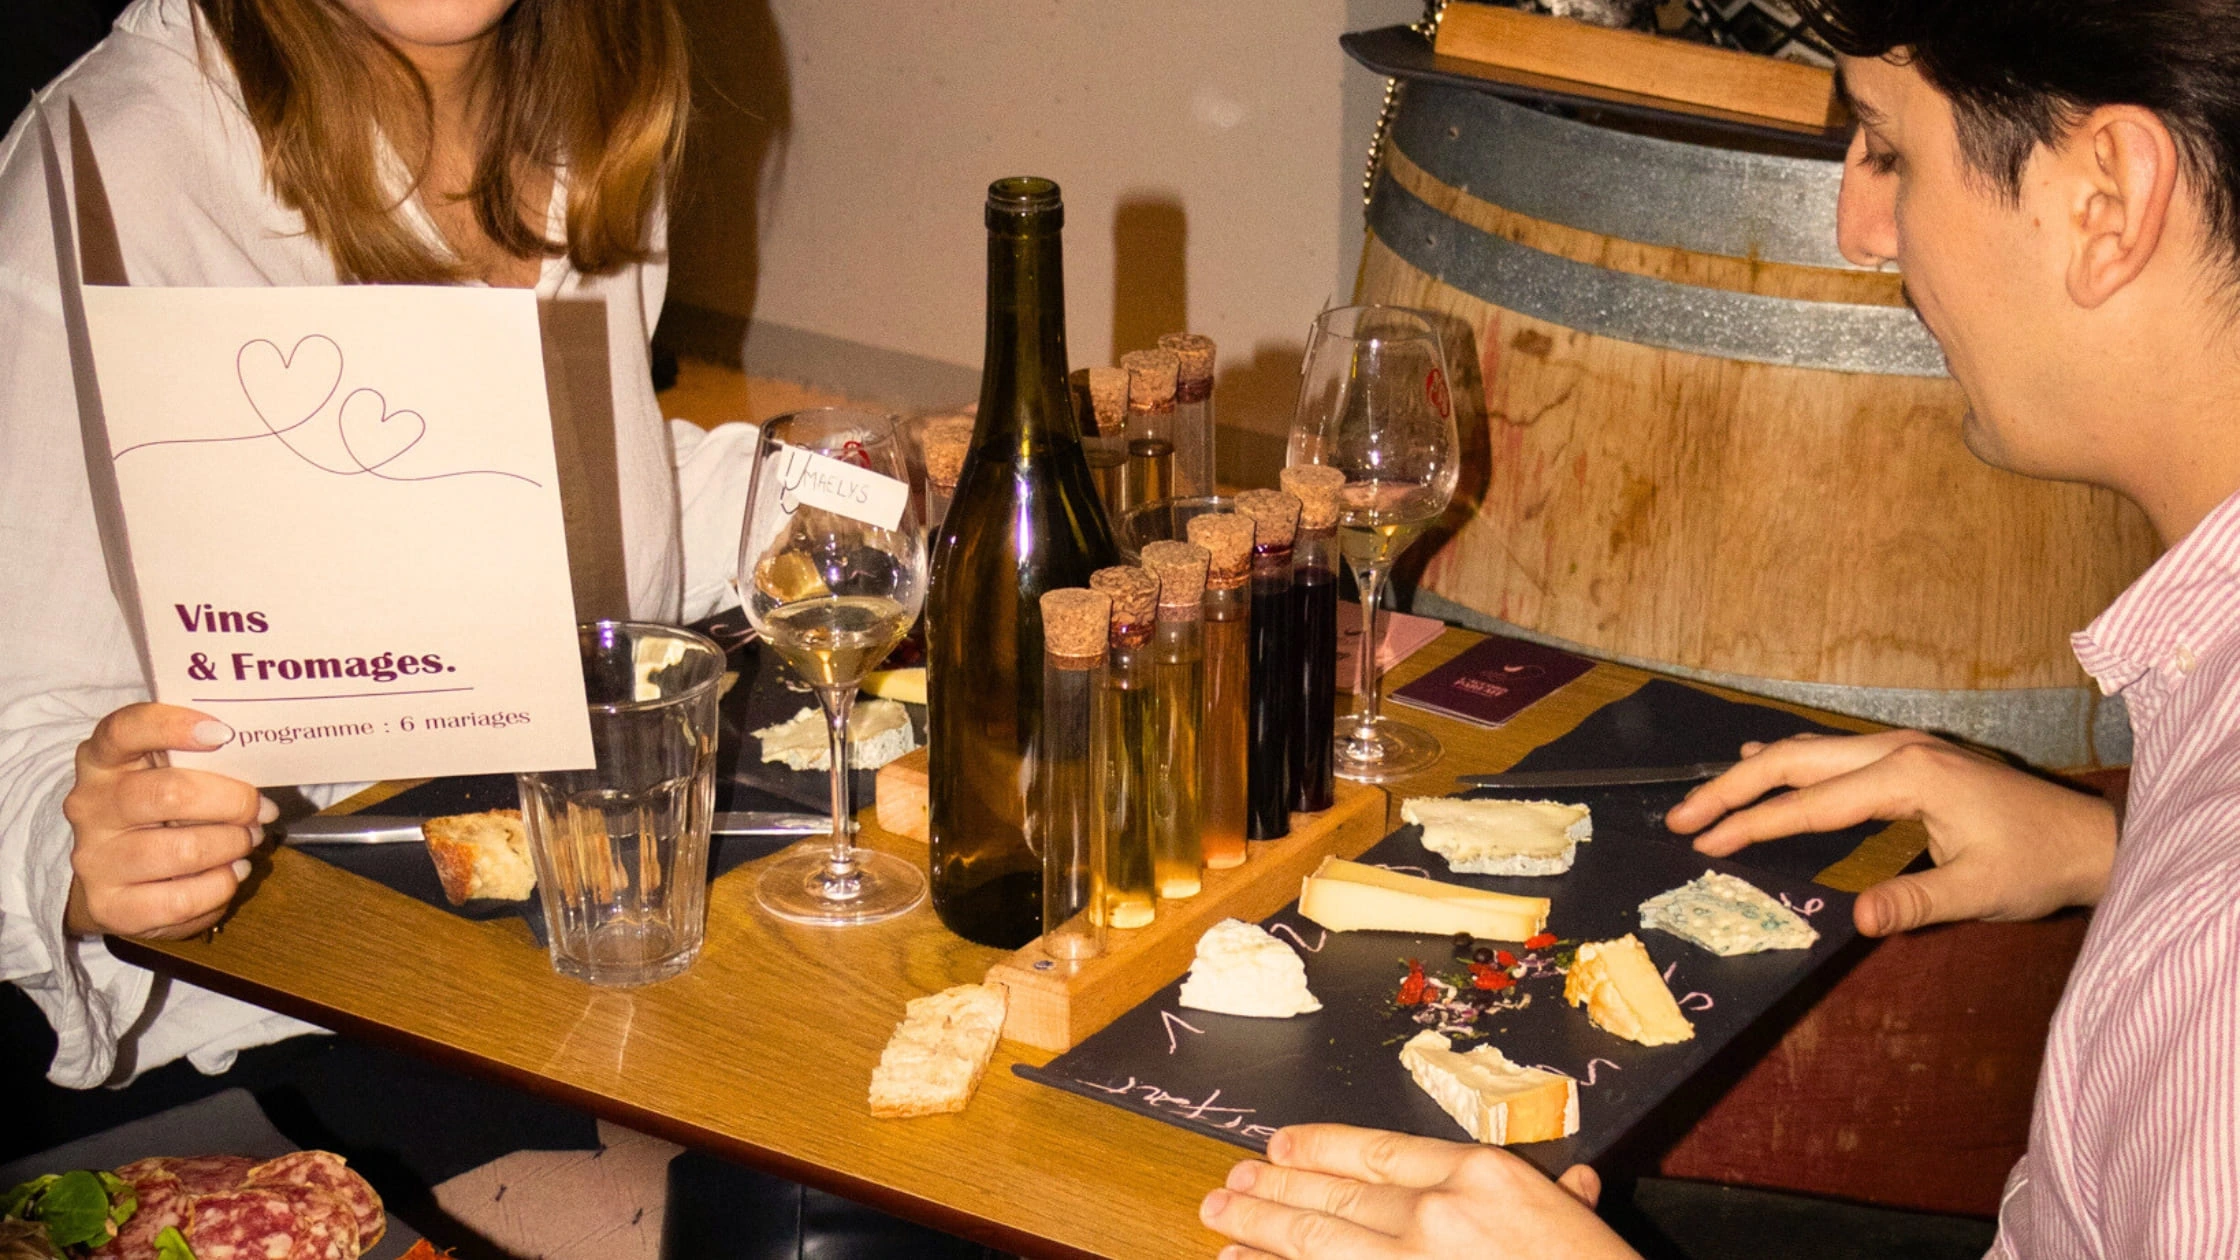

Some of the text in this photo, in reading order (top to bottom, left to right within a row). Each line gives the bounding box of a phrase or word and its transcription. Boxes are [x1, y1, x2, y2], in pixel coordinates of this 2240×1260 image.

[174, 604, 269, 634] Vins
[187, 651, 456, 683] & Fromages.
[239, 711, 531, 748] programme : 6 mariages
